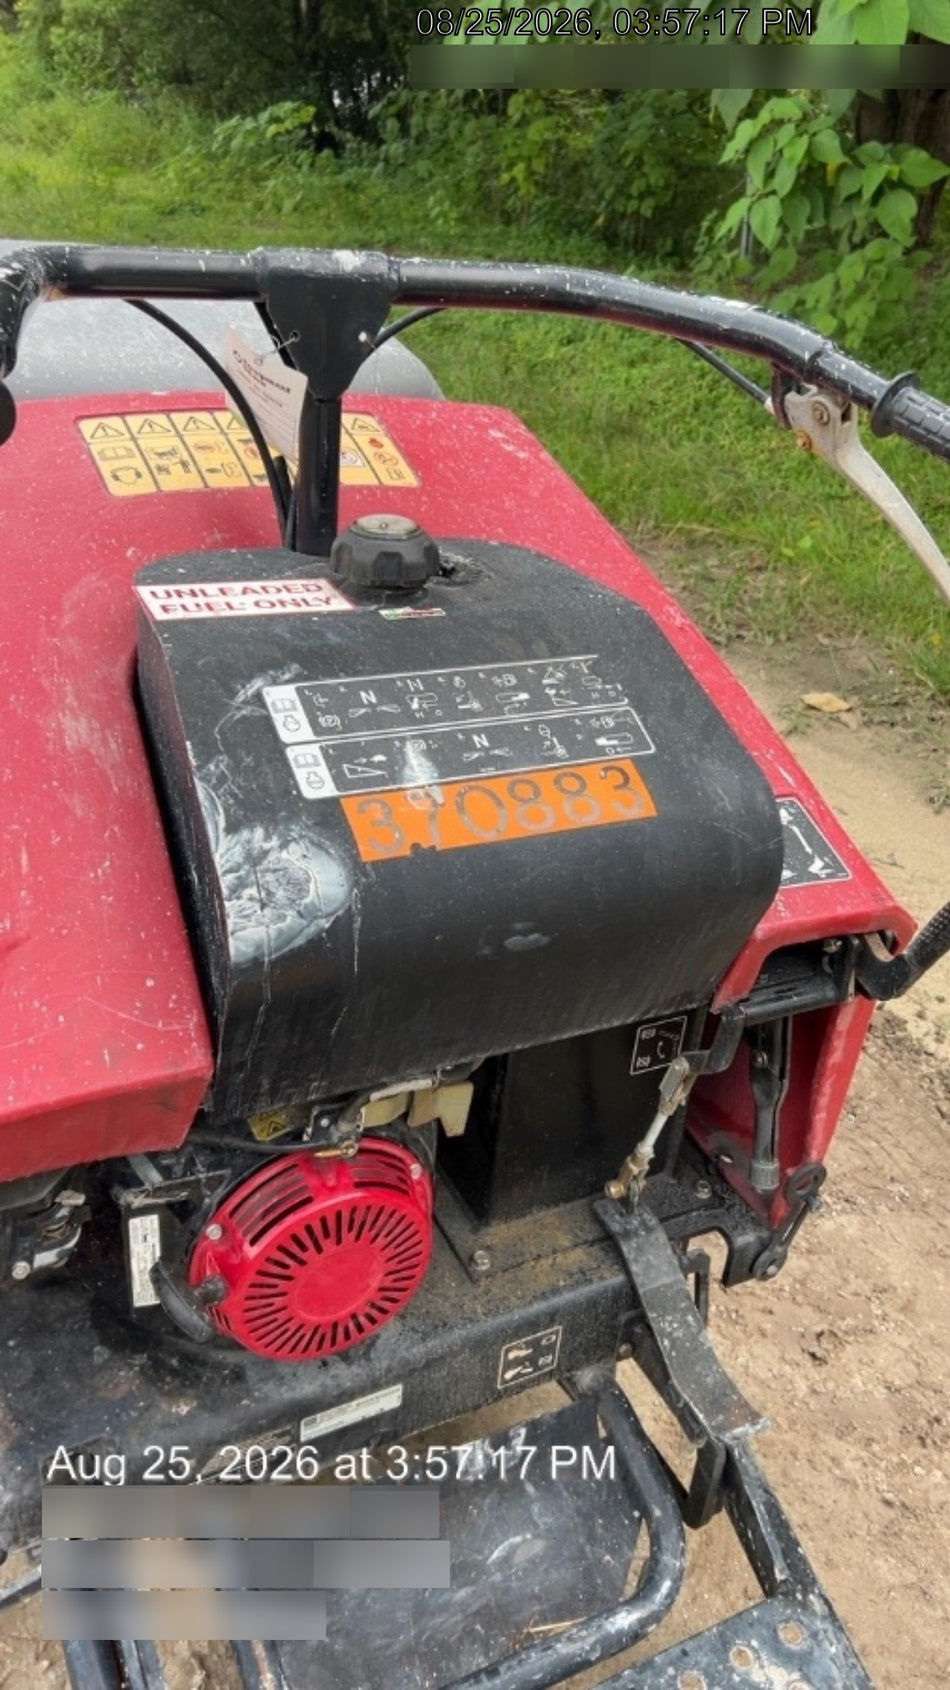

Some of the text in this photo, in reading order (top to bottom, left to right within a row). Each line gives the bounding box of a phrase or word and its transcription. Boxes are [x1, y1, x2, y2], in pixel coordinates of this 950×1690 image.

[150, 583, 323, 600] UNLEADED
[160, 596, 333, 615] FUEL ONLY
[360, 689, 378, 705] N
[472, 733, 490, 749] N
[357, 765, 646, 855] 370883
